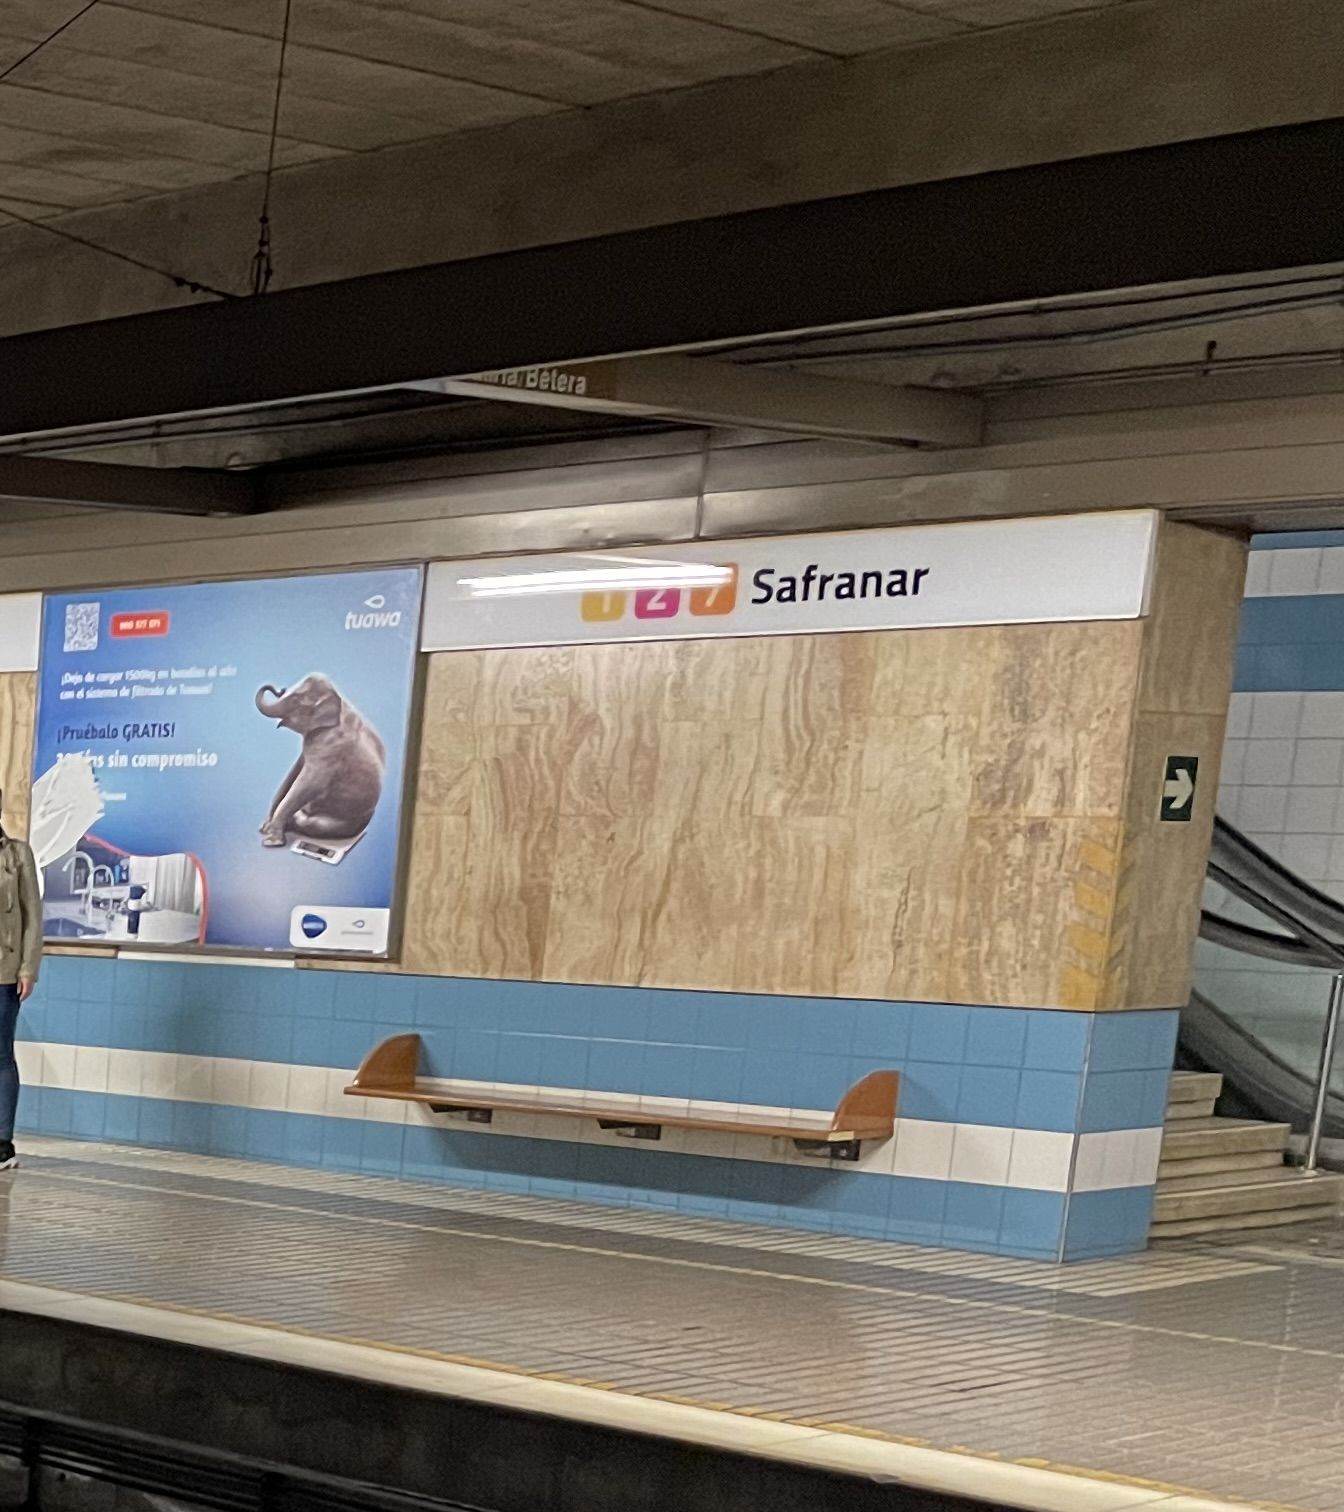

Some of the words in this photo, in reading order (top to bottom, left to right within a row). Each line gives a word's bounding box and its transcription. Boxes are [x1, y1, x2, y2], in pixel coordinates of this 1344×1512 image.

[751, 563, 931, 605] Safranar
[57, 722, 119, 744] ¡Pruébalo
[122, 722, 176, 743] GRATIS!
[108, 749, 128, 768] sin
[131, 748, 218, 772] compromiso
